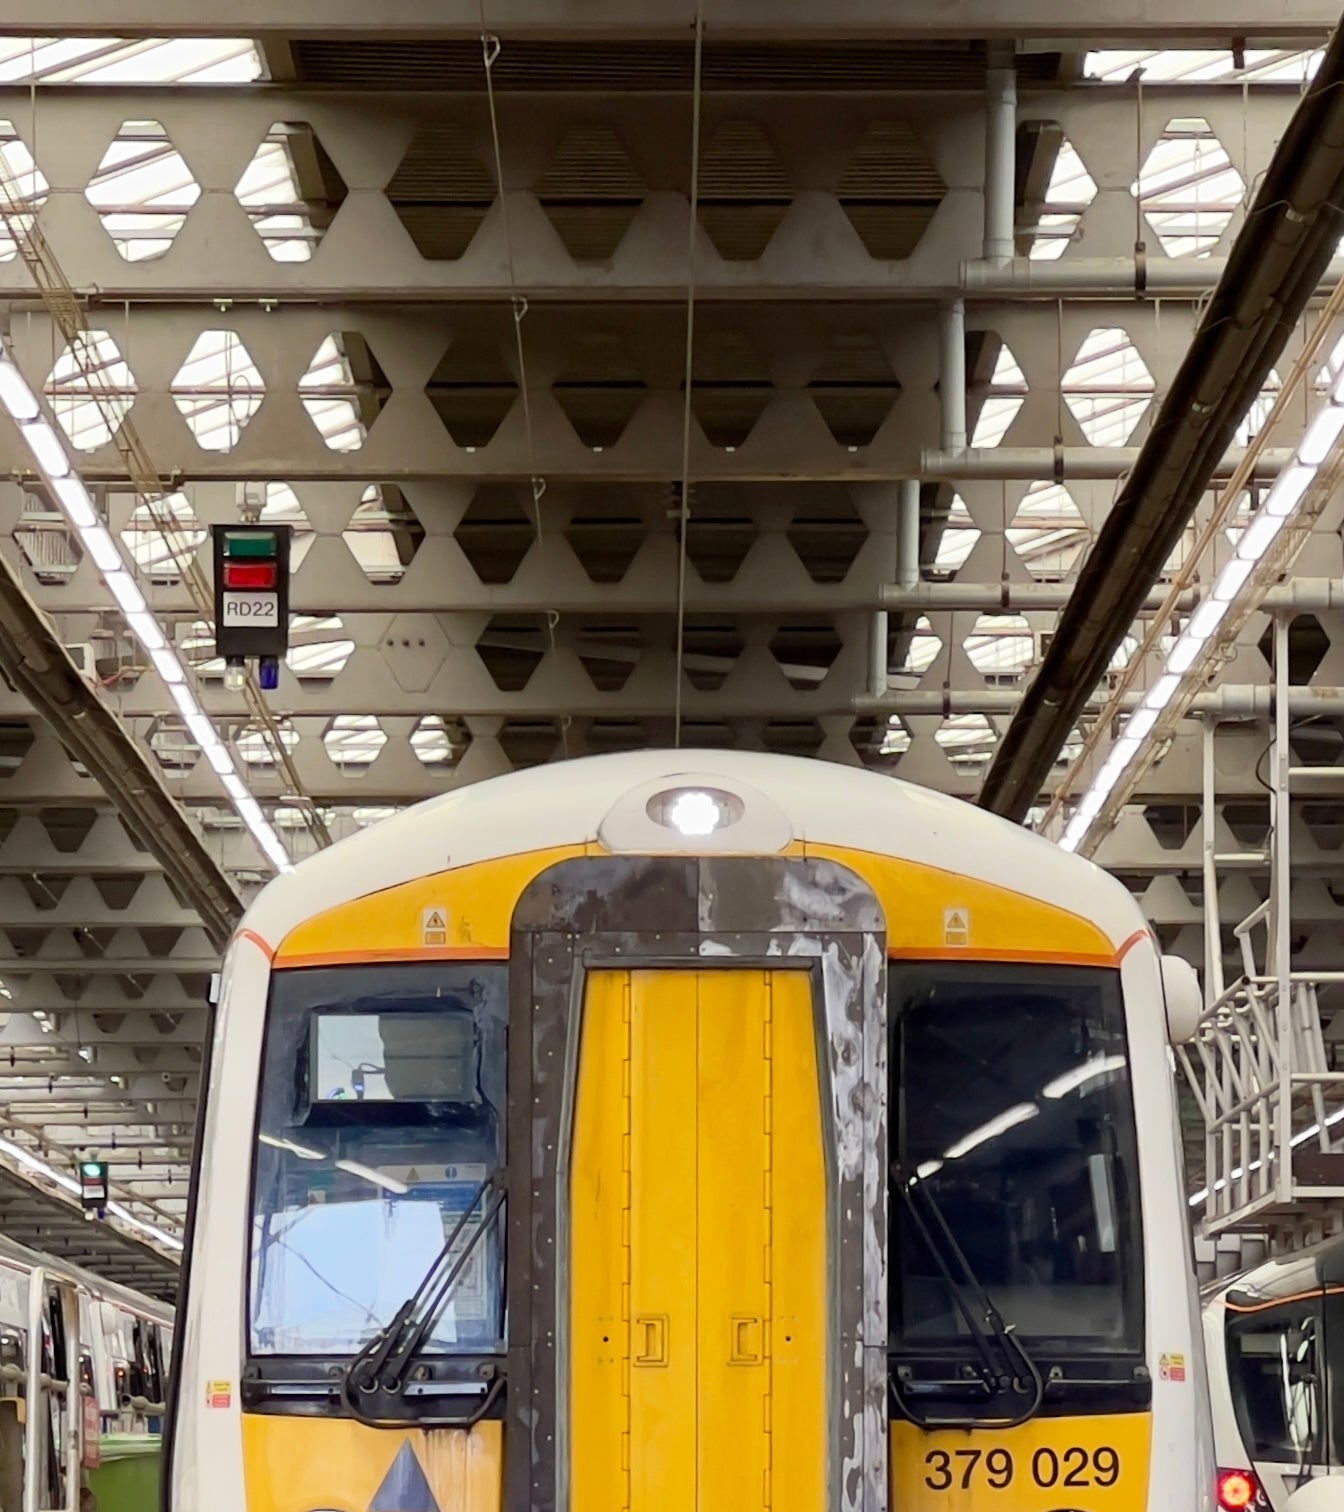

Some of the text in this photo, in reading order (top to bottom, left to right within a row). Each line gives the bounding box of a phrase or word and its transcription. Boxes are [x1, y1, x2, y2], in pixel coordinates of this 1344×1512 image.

[227, 601, 275, 617] RD22
[924, 1446, 1120, 1490] 379 029
